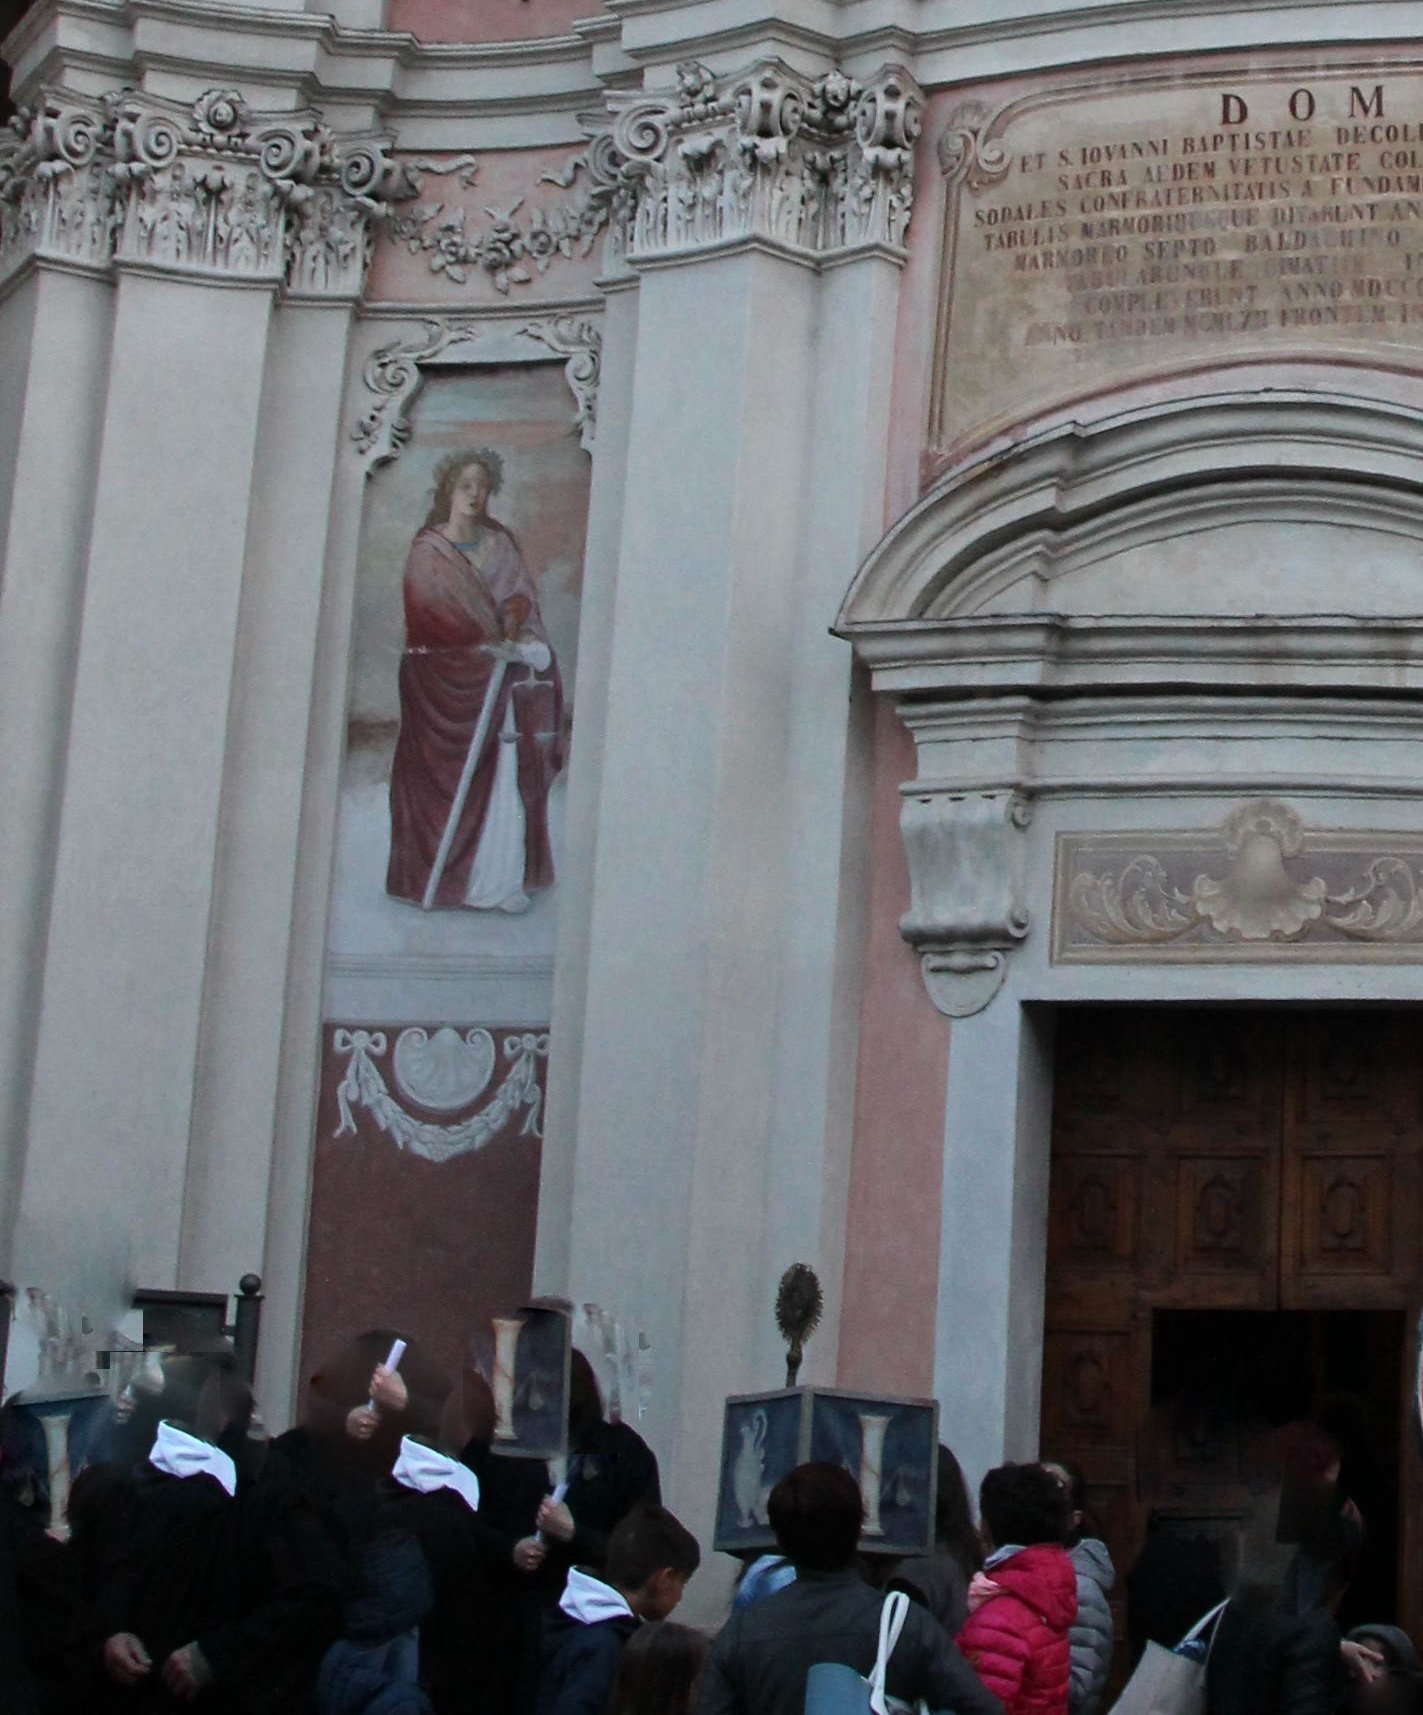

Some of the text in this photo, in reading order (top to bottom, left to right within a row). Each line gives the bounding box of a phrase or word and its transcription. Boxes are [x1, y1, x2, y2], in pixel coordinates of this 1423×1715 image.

[1221, 85, 1385, 125] D O M
[1021, 152, 1047, 174] ET
[1182, 129, 1311, 156] BAPTISTAE
[1229, 152, 1361, 177] VETUSTATE
[975, 198, 1067, 228] SODALES
[1079, 180, 1291, 215] CONFRATERNITATIS
[1302, 179, 1313, 197] A
[984, 223, 1070, 252] TABULIS
[1144, 237, 1217, 262] SEPTO
[1245, 227, 1400, 254] BALDAHIO
[1084, 285, 1257, 315] COMPLEERUNT
